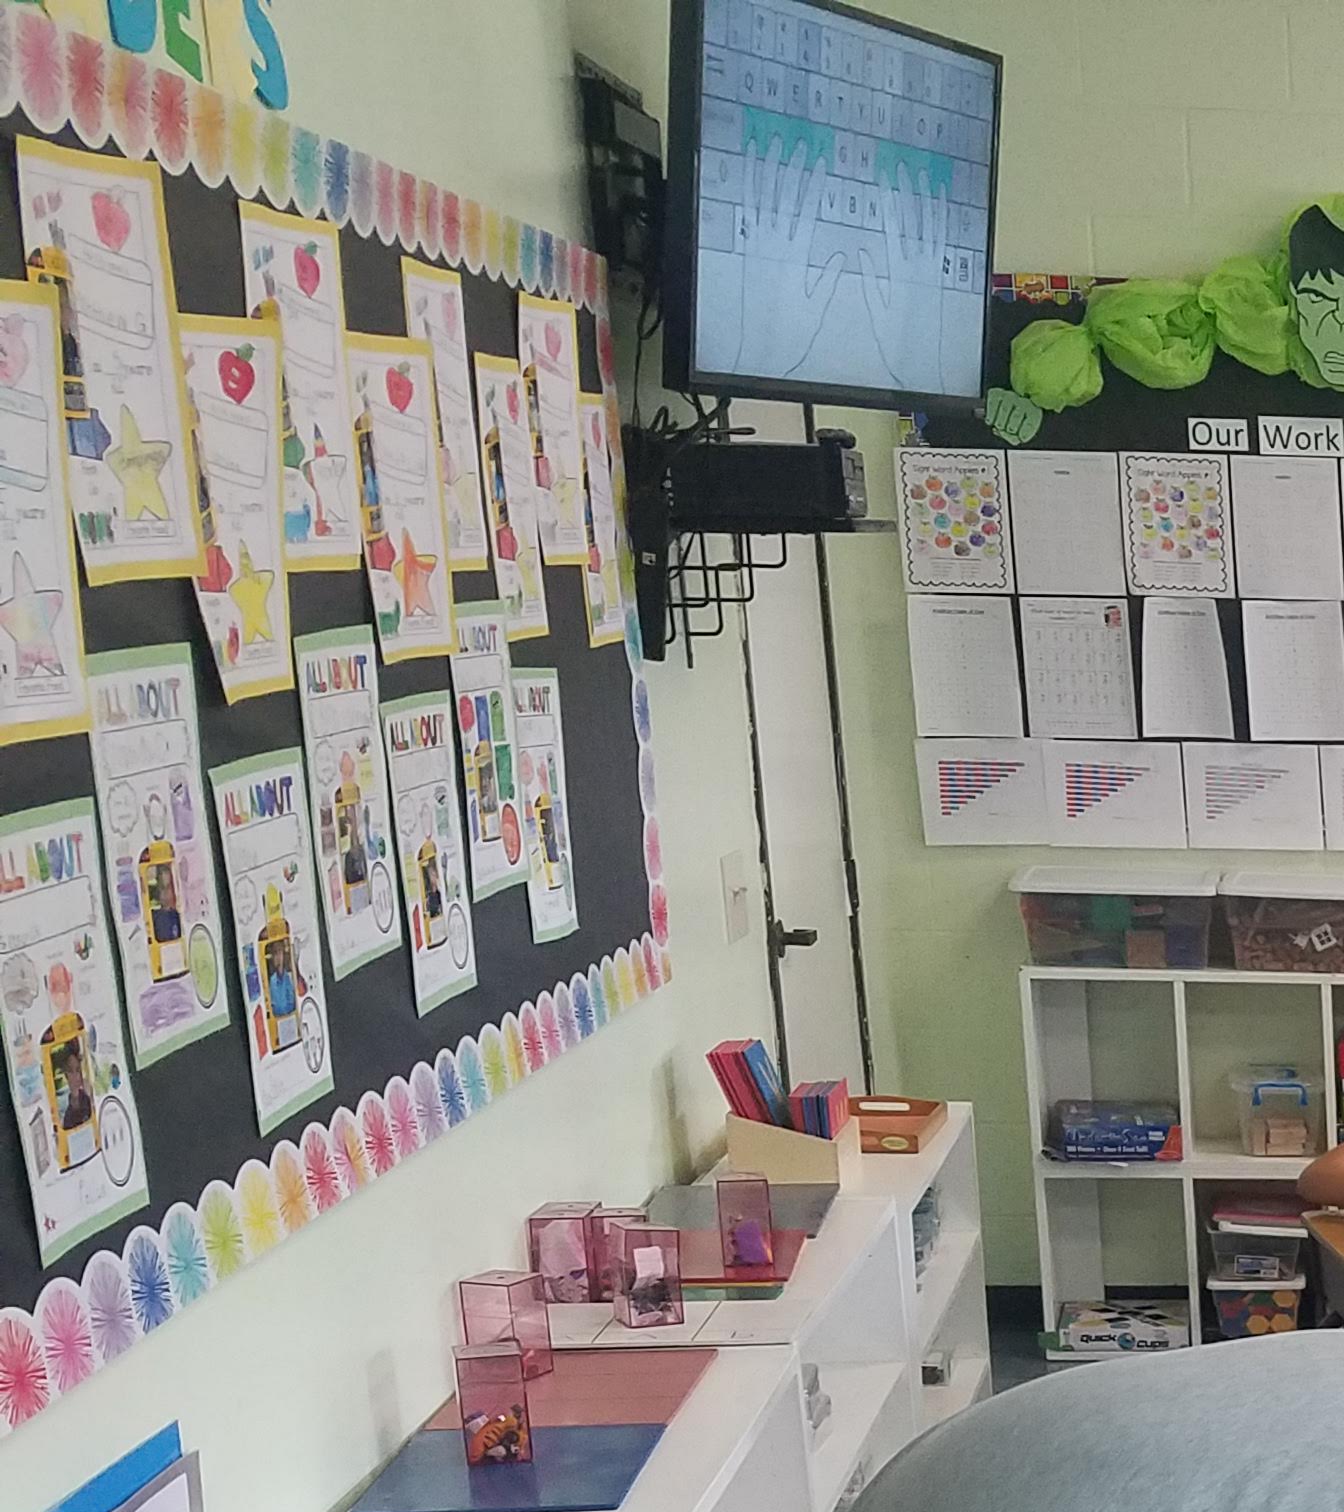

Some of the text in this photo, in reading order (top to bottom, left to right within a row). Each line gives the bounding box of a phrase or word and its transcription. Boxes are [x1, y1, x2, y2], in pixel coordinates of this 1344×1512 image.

[766, 78, 778, 96] W
[1192, 421, 1244, 447] Our
[1264, 424, 1340, 450] Work
[328, 654, 368, 690] ABOUT
[390, 713, 445, 752] ALL ABOUT
[224, 776, 293, 829] ALL ABOUT
[26, 831, 83, 886] ABOUT
[1080, 1334, 1170, 1349] QUICK CUPS
